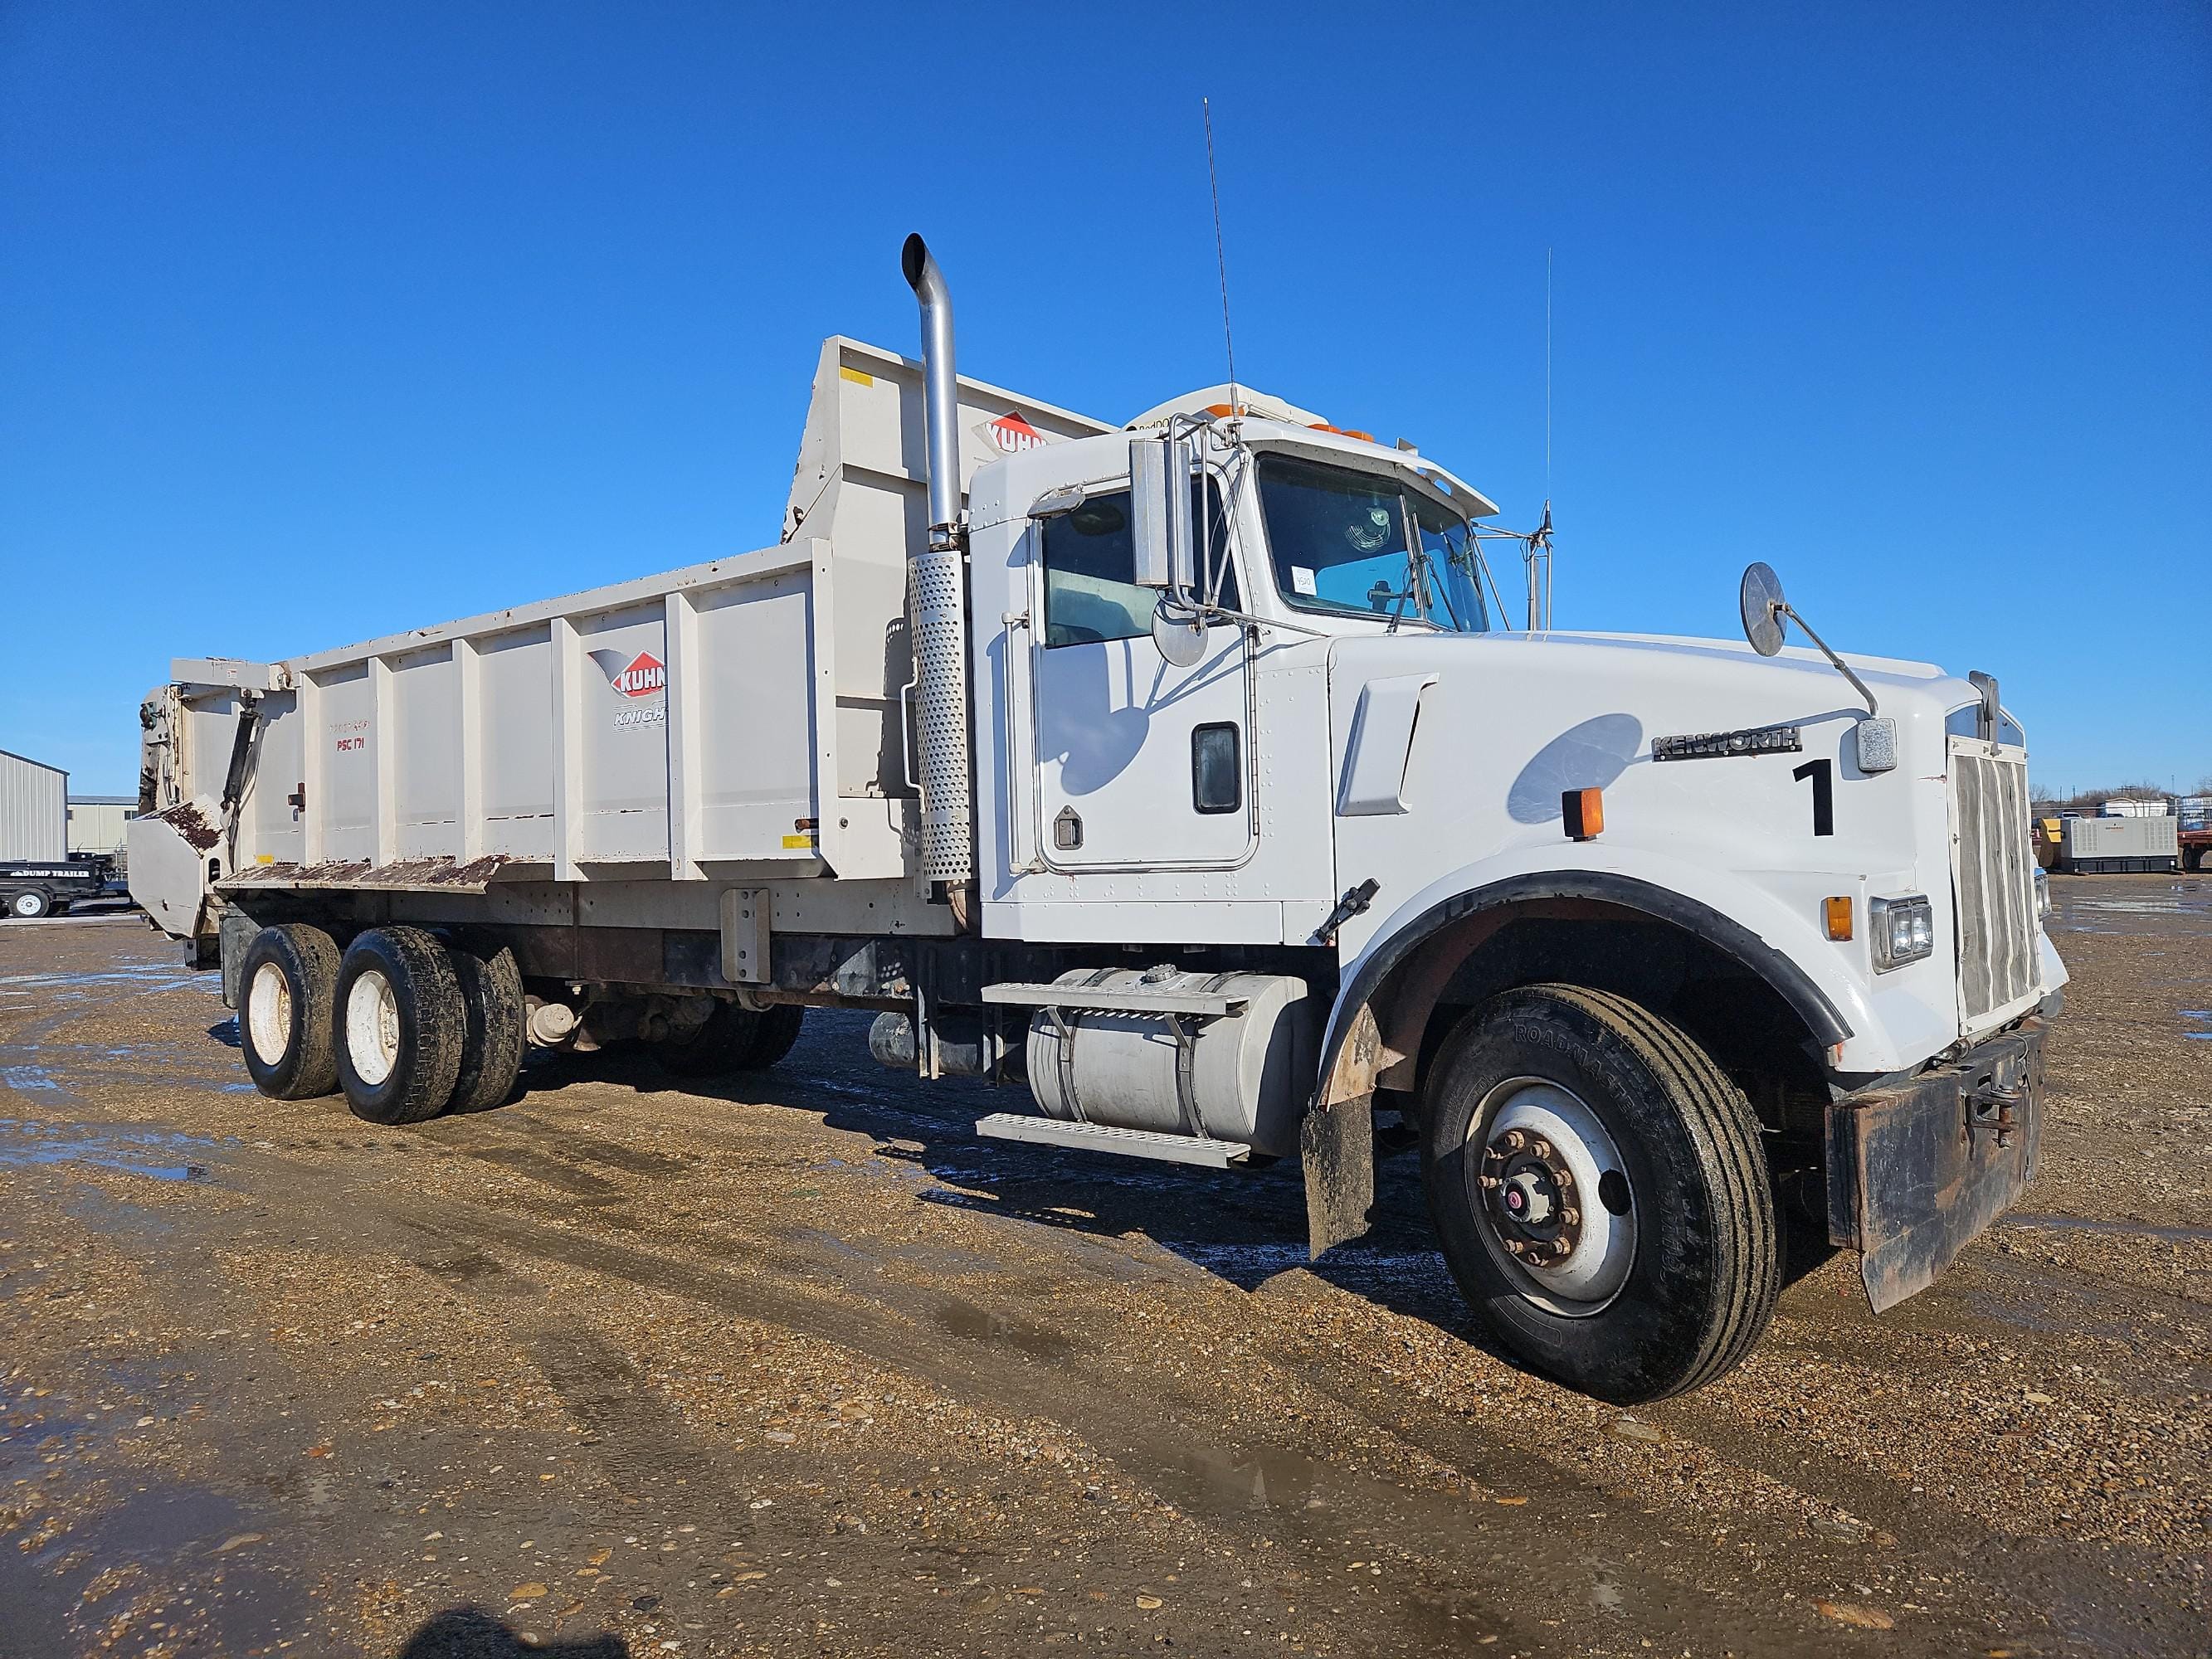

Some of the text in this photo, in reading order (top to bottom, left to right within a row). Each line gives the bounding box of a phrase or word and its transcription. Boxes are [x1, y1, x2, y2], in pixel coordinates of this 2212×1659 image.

[620, 666, 665, 692] KUHN
[613, 707, 667, 726] KNIGH
[337, 737, 364, 752] PSC 171
[1653, 727, 1801, 757] KENWORTH
[1791, 758, 1834, 836] 1
